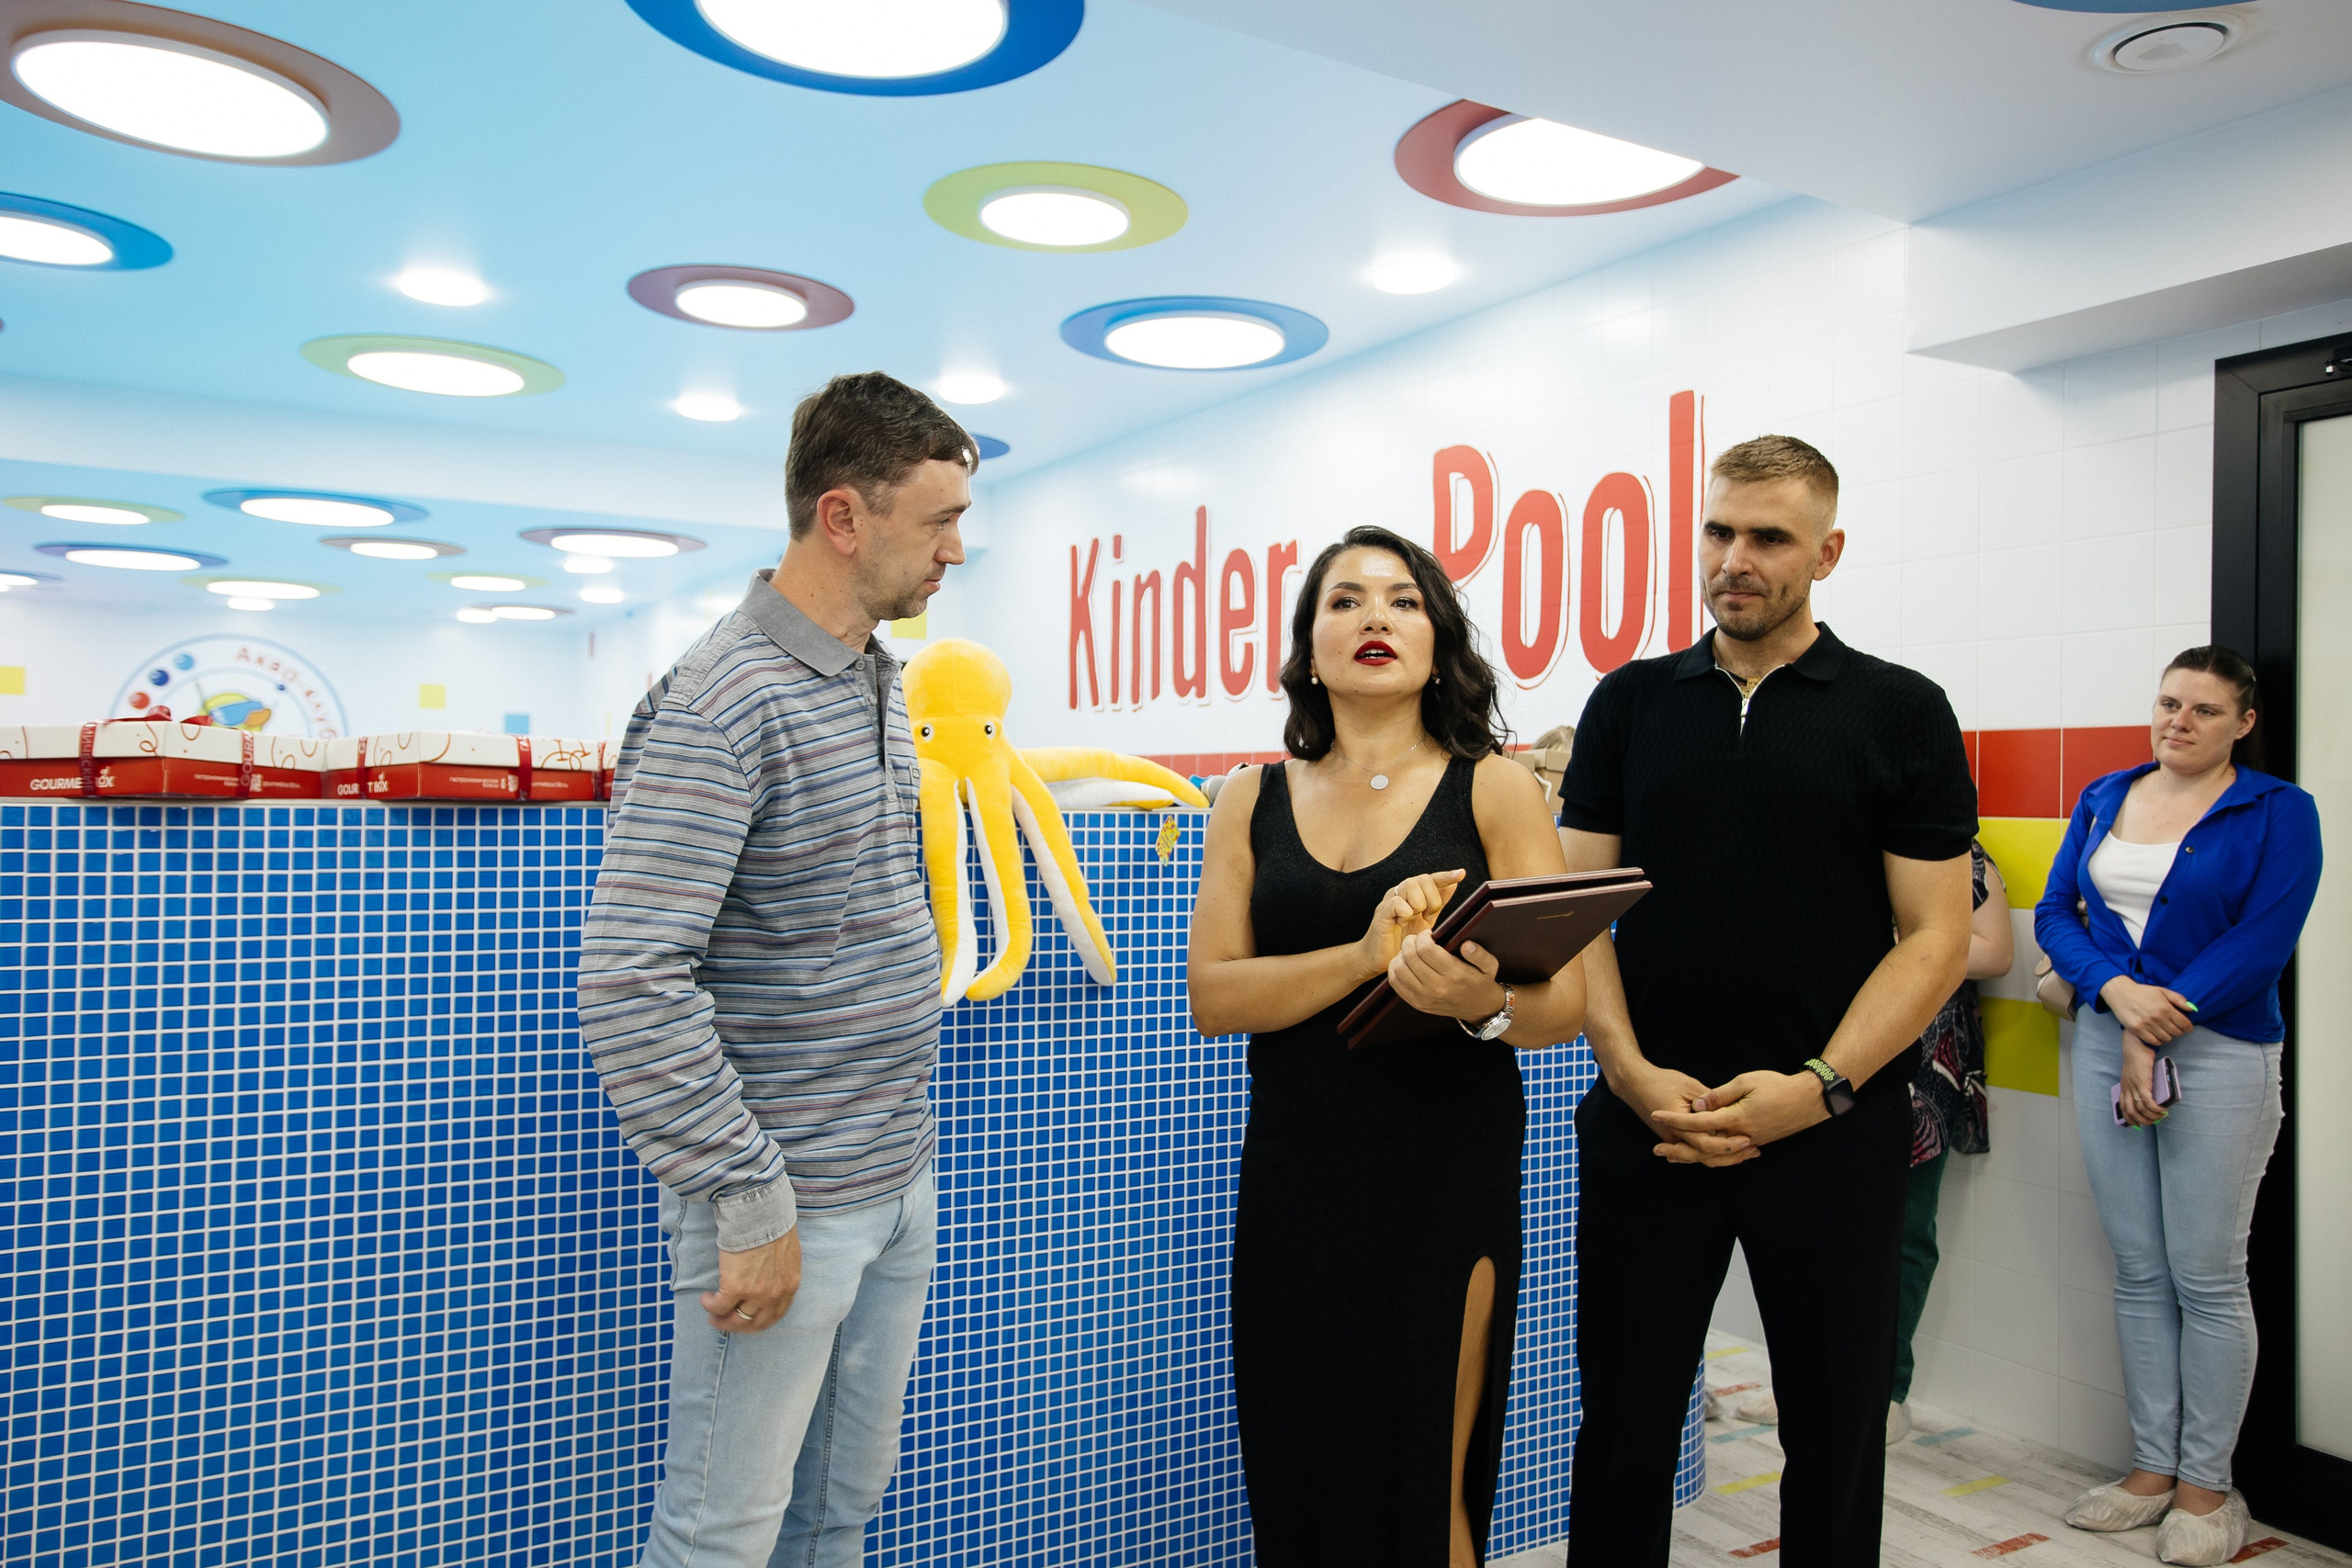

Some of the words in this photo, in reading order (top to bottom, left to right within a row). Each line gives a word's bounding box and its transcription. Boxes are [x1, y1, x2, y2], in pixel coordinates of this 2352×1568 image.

[1069, 505, 1300, 711] Kinder
[1432, 389, 1702, 684] Pool
[29, 777, 84, 791] GOURME
